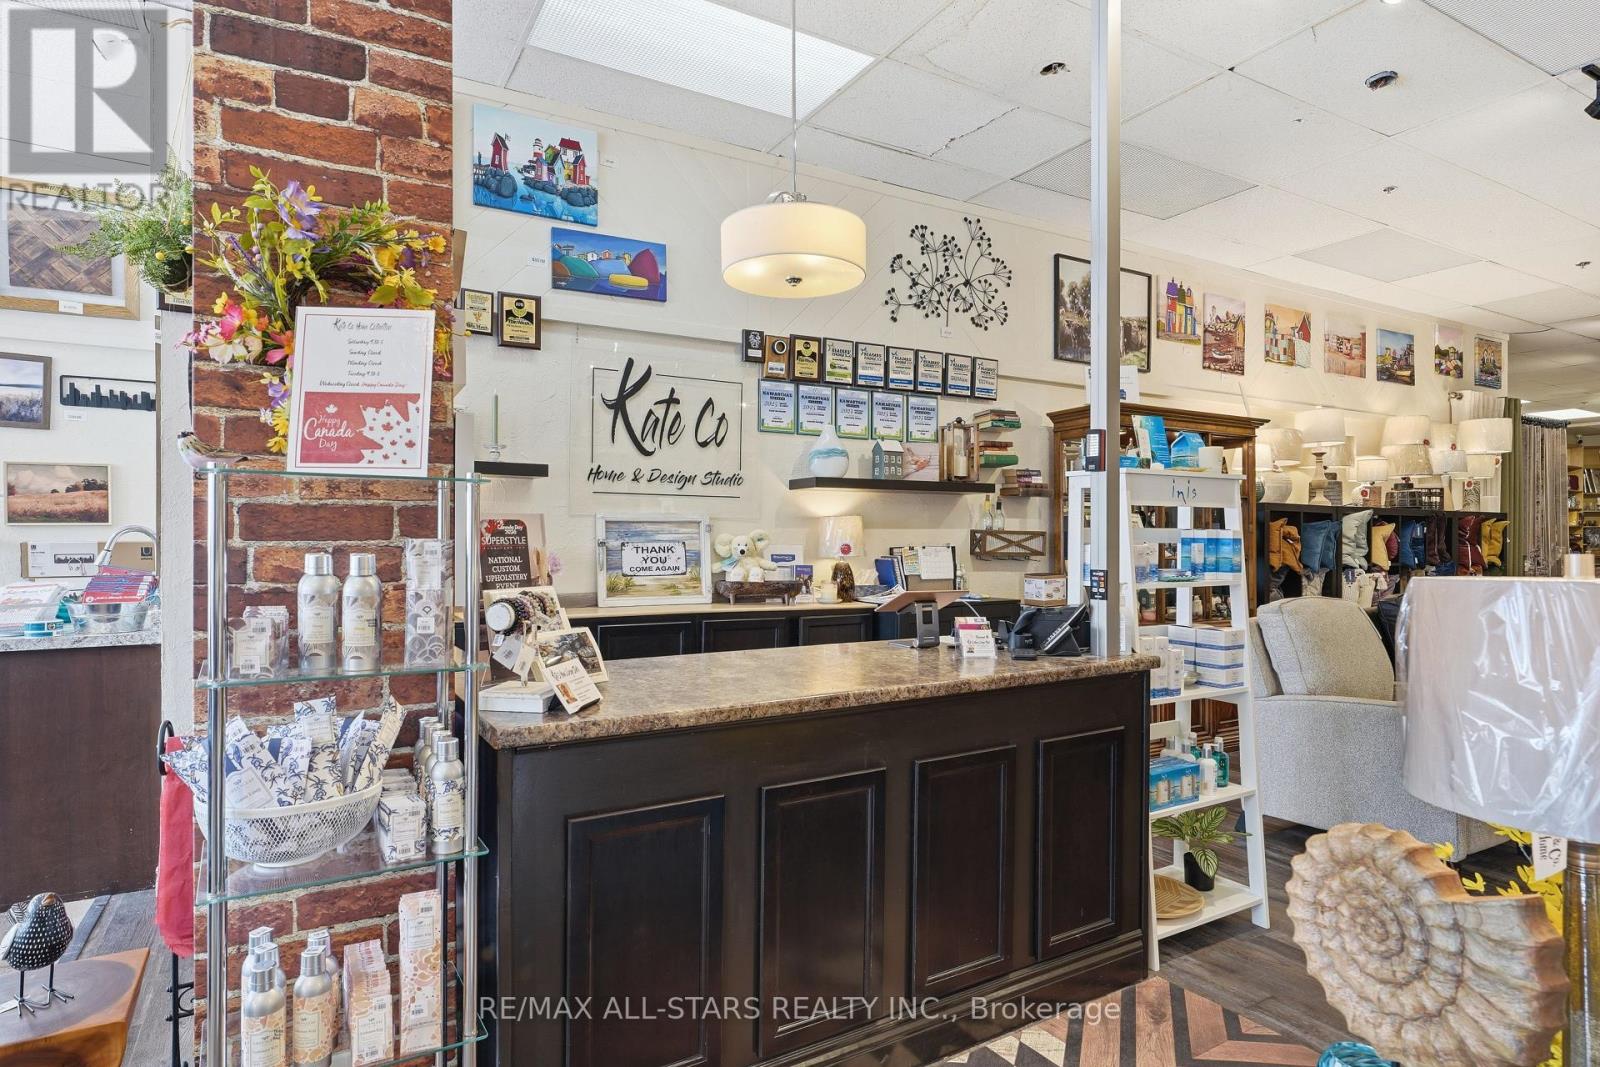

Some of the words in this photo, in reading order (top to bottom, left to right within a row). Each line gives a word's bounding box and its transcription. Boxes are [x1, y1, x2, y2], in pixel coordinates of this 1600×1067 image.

[600, 357, 686, 456] Kate
[694, 397, 728, 448] Co
[318, 415, 340, 427] Happy
[304, 417, 354, 440] Canada
[318, 438, 337, 452] Day
[587, 464, 626, 485] Home
[632, 468, 644, 483] &
[647, 468, 696, 490] Design
[700, 471, 744, 486] Studio
[482, 536, 526, 545] SUPERSTYLE
[633, 546, 675, 554] THANK
[488, 556, 523, 564] NATIONAL
[642, 556, 668, 564] YOU
[492, 565, 520, 573] CUSTOM
[485, 573, 528, 582] UPHOLSTERY
